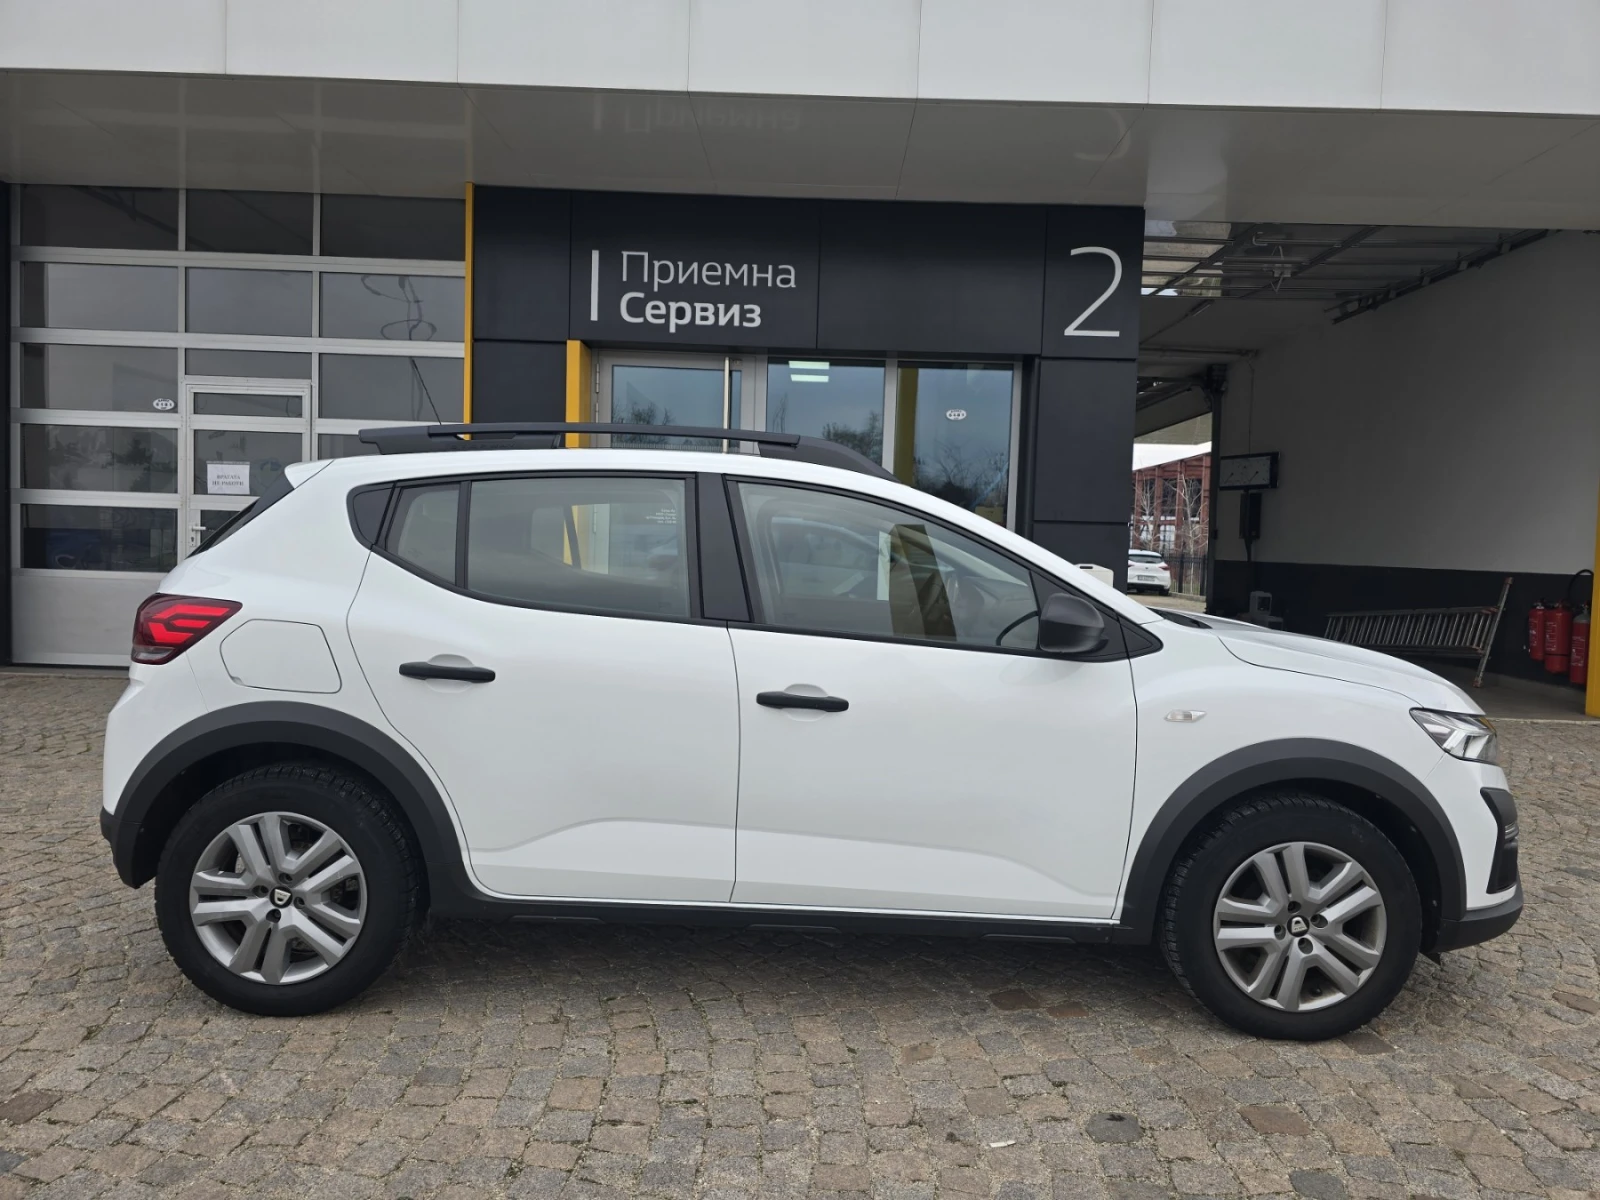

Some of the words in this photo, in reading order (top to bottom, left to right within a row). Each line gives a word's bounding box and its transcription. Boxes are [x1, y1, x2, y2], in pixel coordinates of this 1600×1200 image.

[621, 250, 797, 292] Приемна
[1064, 246, 1122, 337] 2
[619, 291, 762, 333] Сервиз
